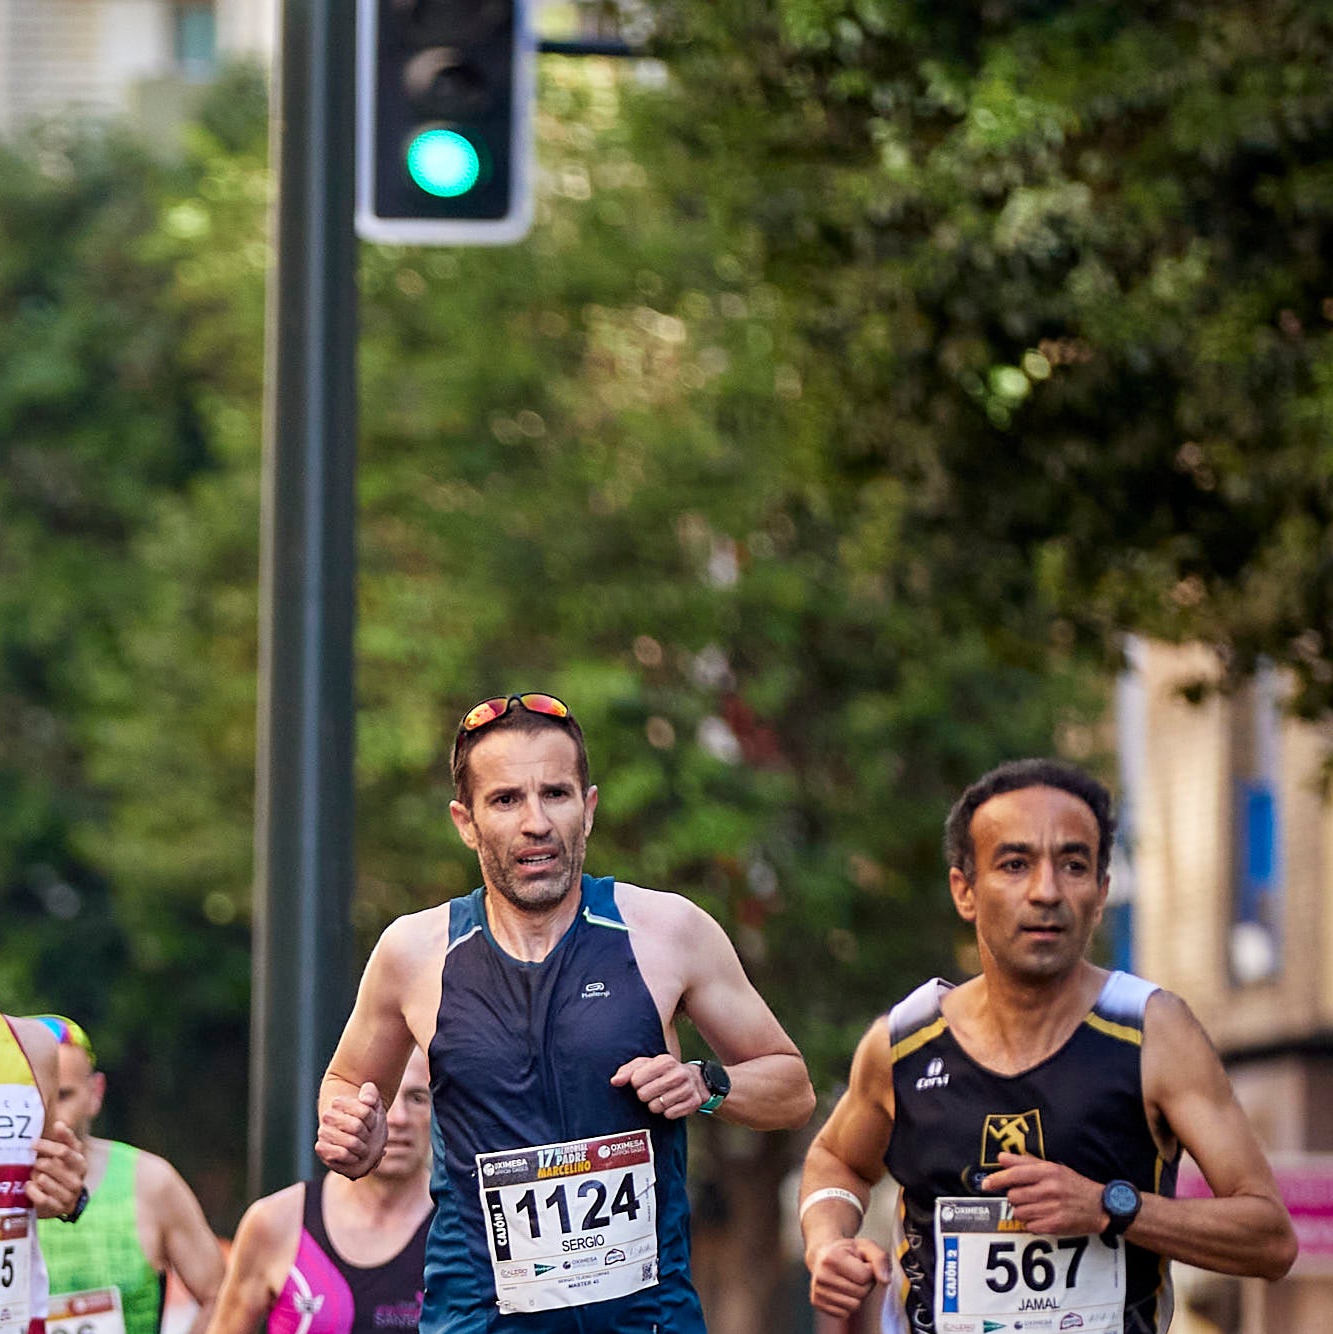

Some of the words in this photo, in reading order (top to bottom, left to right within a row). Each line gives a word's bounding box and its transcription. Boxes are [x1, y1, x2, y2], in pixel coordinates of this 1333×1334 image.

[611, 1139, 645, 1151] OXIMESA
[494, 1158, 528, 1170] OXIMESA
[537, 1148, 555, 1168] 17
[555, 1143, 588, 1156] MEMORIAL
[556, 1151, 587, 1166] PADRE
[537, 1160, 592, 1179] MARCELINO
[516, 1172, 641, 1239] 1124
[493, 1211, 508, 1247] CAJÓN
[562, 1234, 605, 1252] SERGIO
[948, 1250, 958, 1258] 2
[985, 1237, 1089, 1293] 567
[946, 1263, 958, 1299] CAJÓN
[1018, 1298, 1060, 1312] JAMAL
